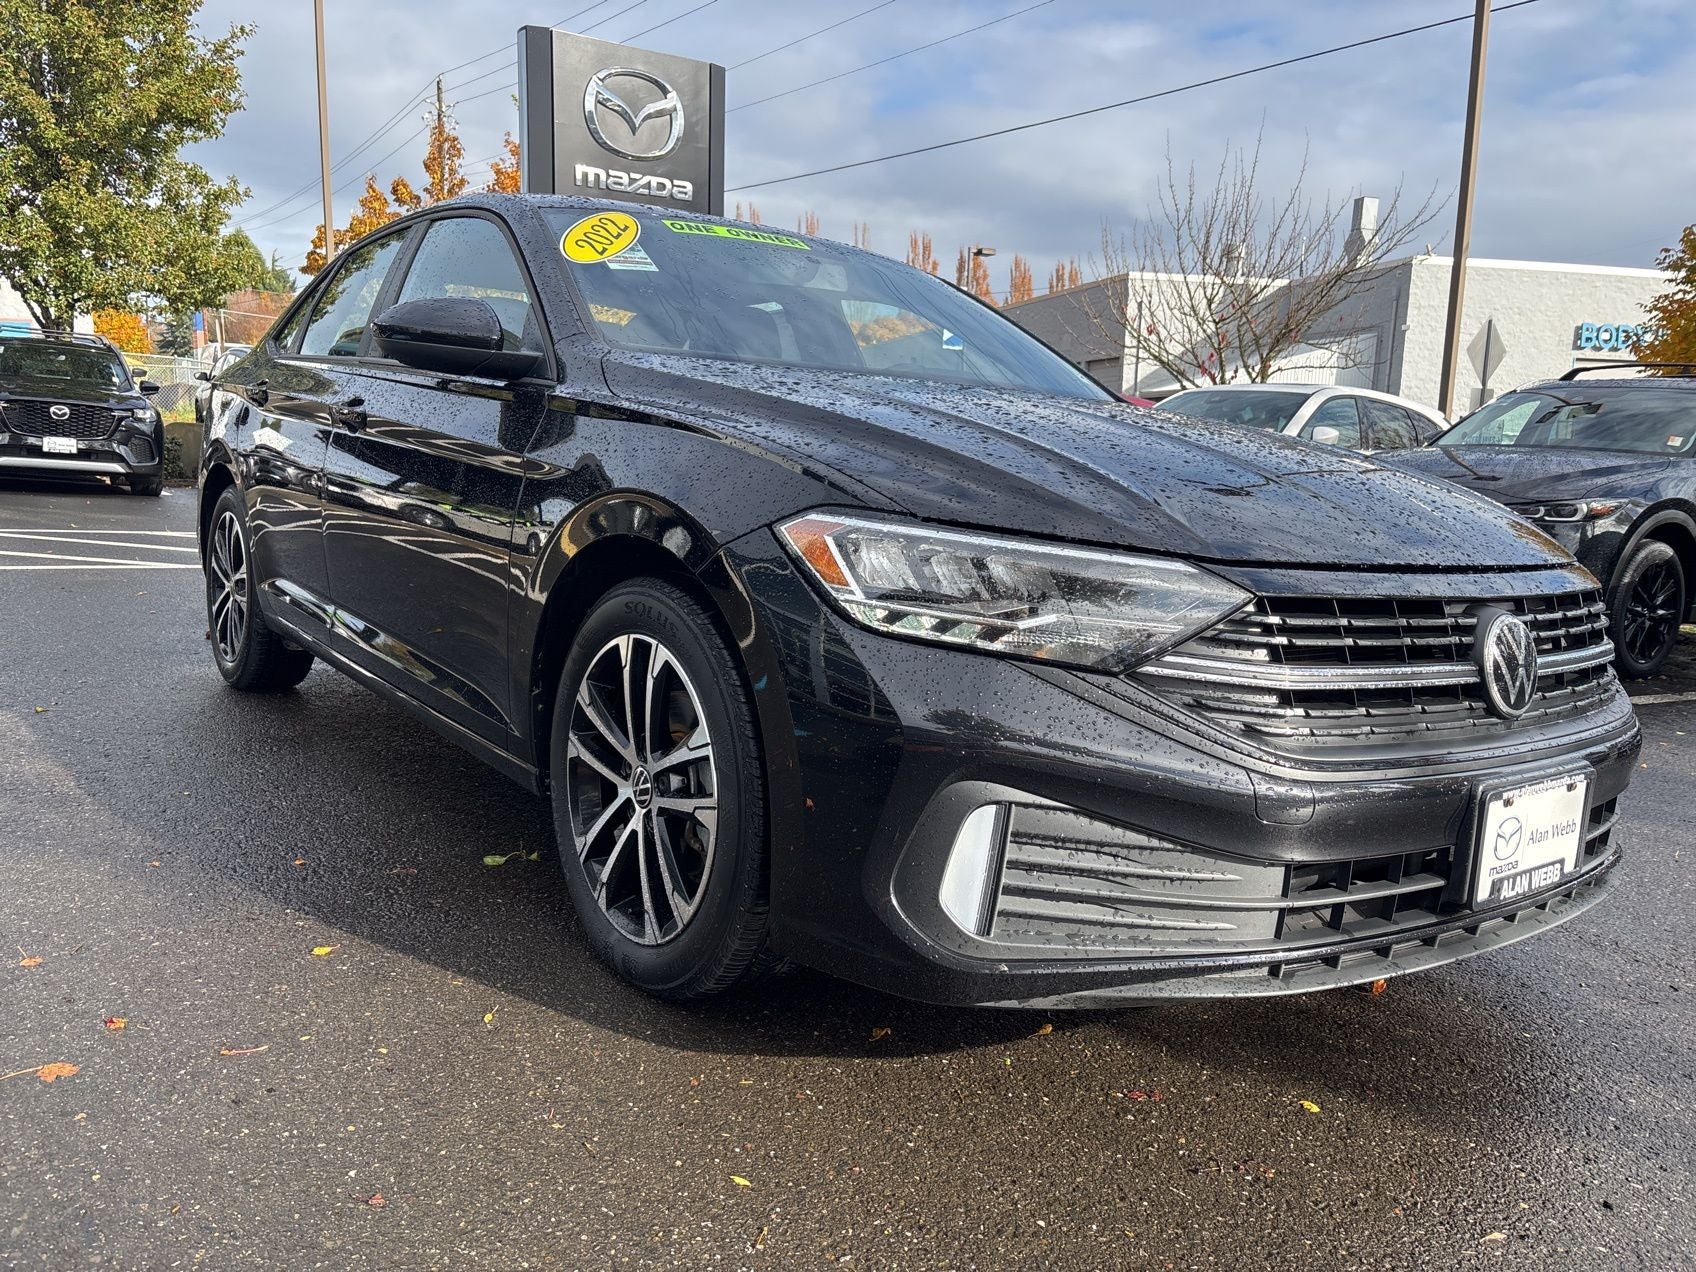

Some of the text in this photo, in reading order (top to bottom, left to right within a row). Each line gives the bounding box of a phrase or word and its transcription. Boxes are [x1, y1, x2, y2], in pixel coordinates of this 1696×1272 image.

[575, 216, 630, 257] 2022
[669, 222, 805, 249] ONE OWNER
[1527, 819, 1577, 846] Alan Webb
[1500, 863, 1561, 900] ALAN WEBB
